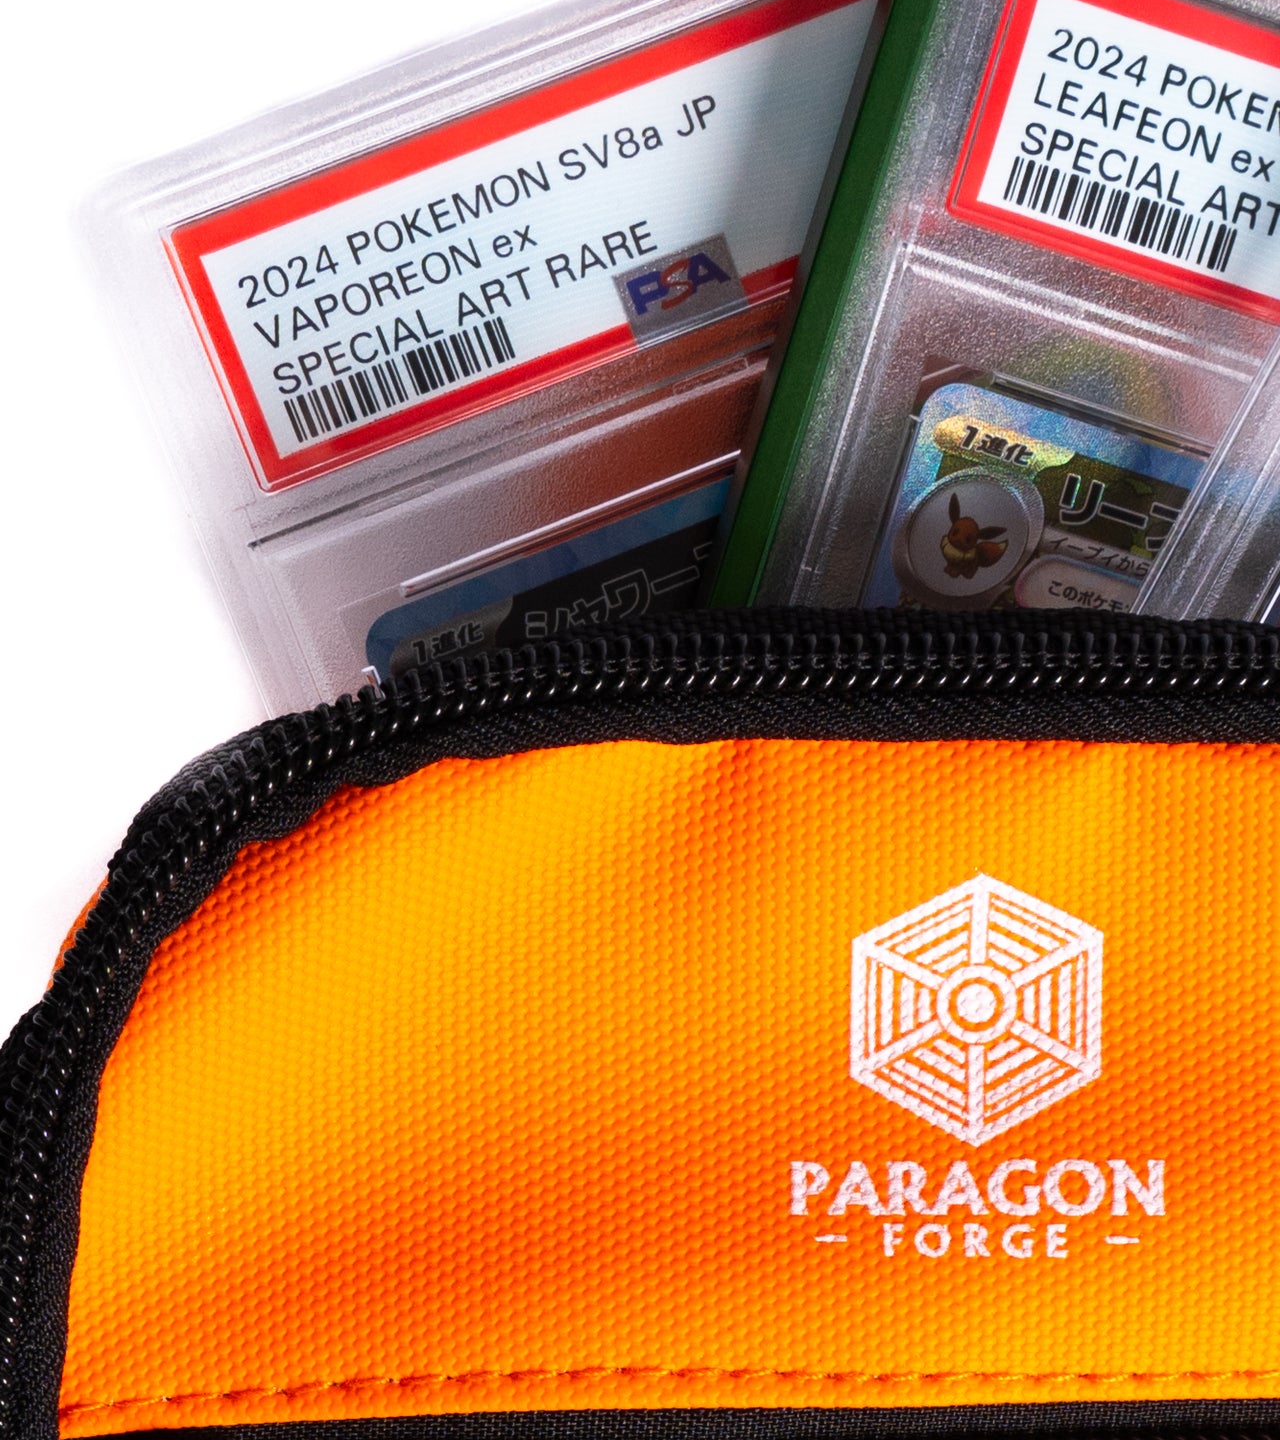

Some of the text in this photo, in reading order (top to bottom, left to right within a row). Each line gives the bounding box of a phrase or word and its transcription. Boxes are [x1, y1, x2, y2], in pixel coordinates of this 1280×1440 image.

[1046, 30, 1148, 88] 2024
[1019, 121, 1185, 207] SPECIAL
[1033, 72, 1276, 183] LEAFEON ex
[238, 94, 717, 310] 2024 POKEMON SV8a JP
[252, 225, 537, 349] VAPOREON ex
[272, 220, 659, 396] SPECIAL ART RARE
[626, 252, 732, 316] PSA
[524, 541, 714, 640] シャワー
[1047, 579, 1132, 612] このポケモ
[788, 1158, 1166, 1217] PARAGON
[882, 1222, 1070, 1259] FORGE
